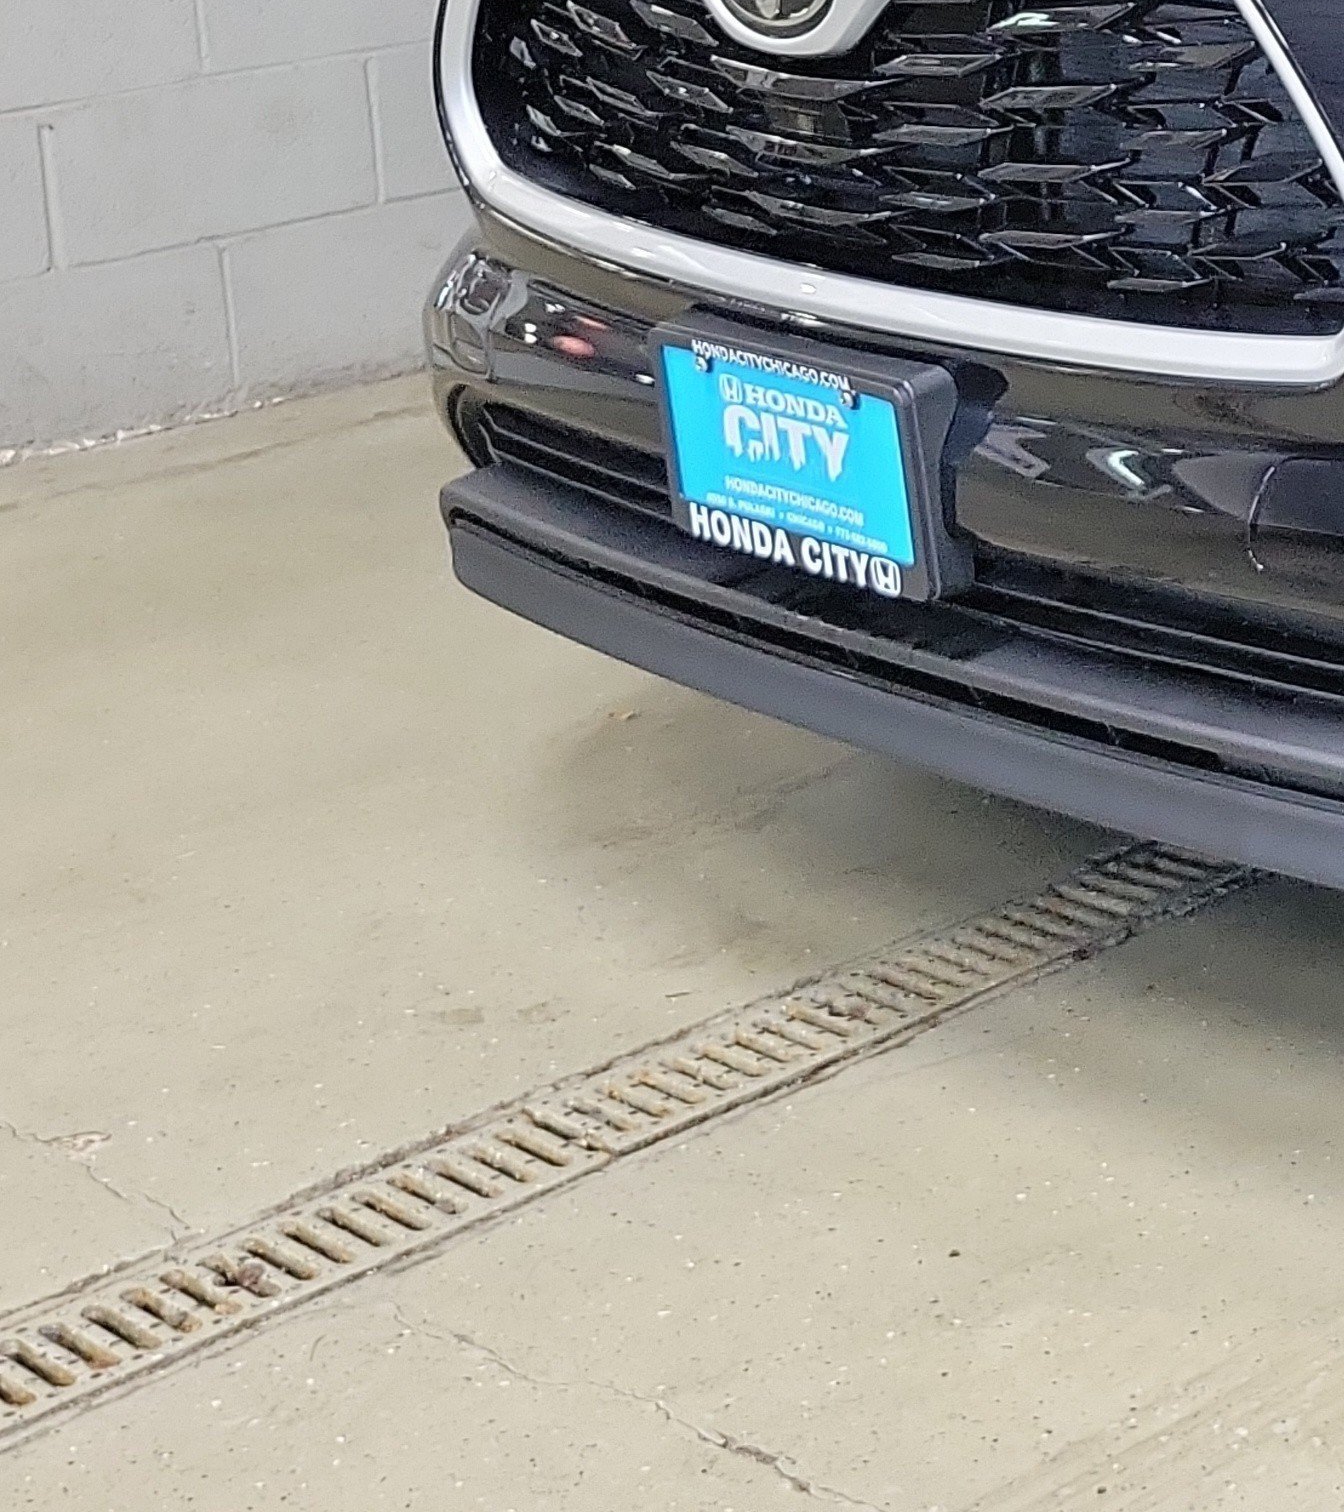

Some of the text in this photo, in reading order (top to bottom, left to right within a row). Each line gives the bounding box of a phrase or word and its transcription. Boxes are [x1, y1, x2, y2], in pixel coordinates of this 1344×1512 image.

[691, 339, 852, 392] HONDACITYCHICAGO.COM
[742, 381, 849, 429] HONDA
[722, 403, 850, 483] CITY
[724, 474, 865, 528] HONDACITYCHICAGO.COM
[688, 501, 796, 567] HONDA
[800, 536, 870, 588] CITY
